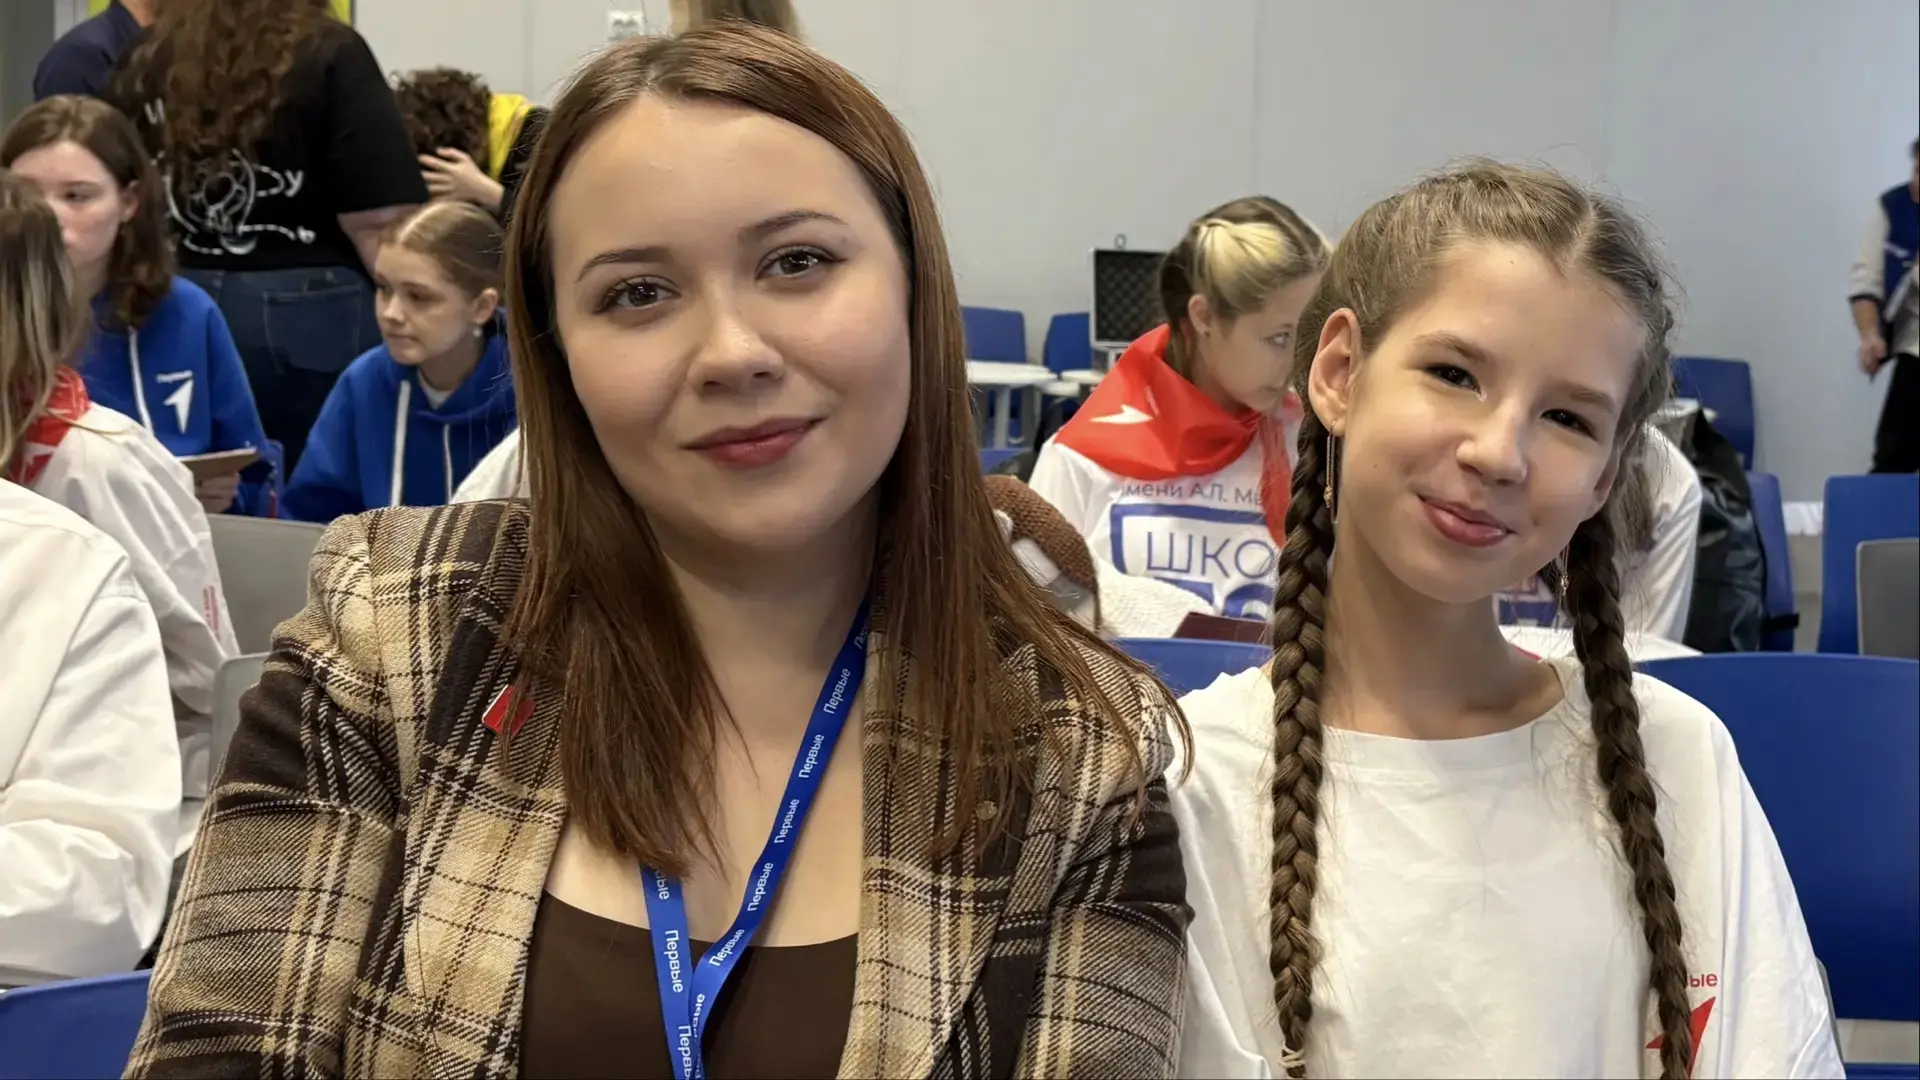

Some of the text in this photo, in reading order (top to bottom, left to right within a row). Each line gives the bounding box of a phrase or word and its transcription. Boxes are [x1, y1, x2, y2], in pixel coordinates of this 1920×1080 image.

[823, 668, 851, 714] Первые
[798, 734, 825, 778] Первые
[774, 798, 800, 843] Первые
[747, 862, 774, 911] Первые
[663, 929, 684, 993] Первые
[708, 929, 745, 966] Первые
[1689, 973, 1718, 988] ые
